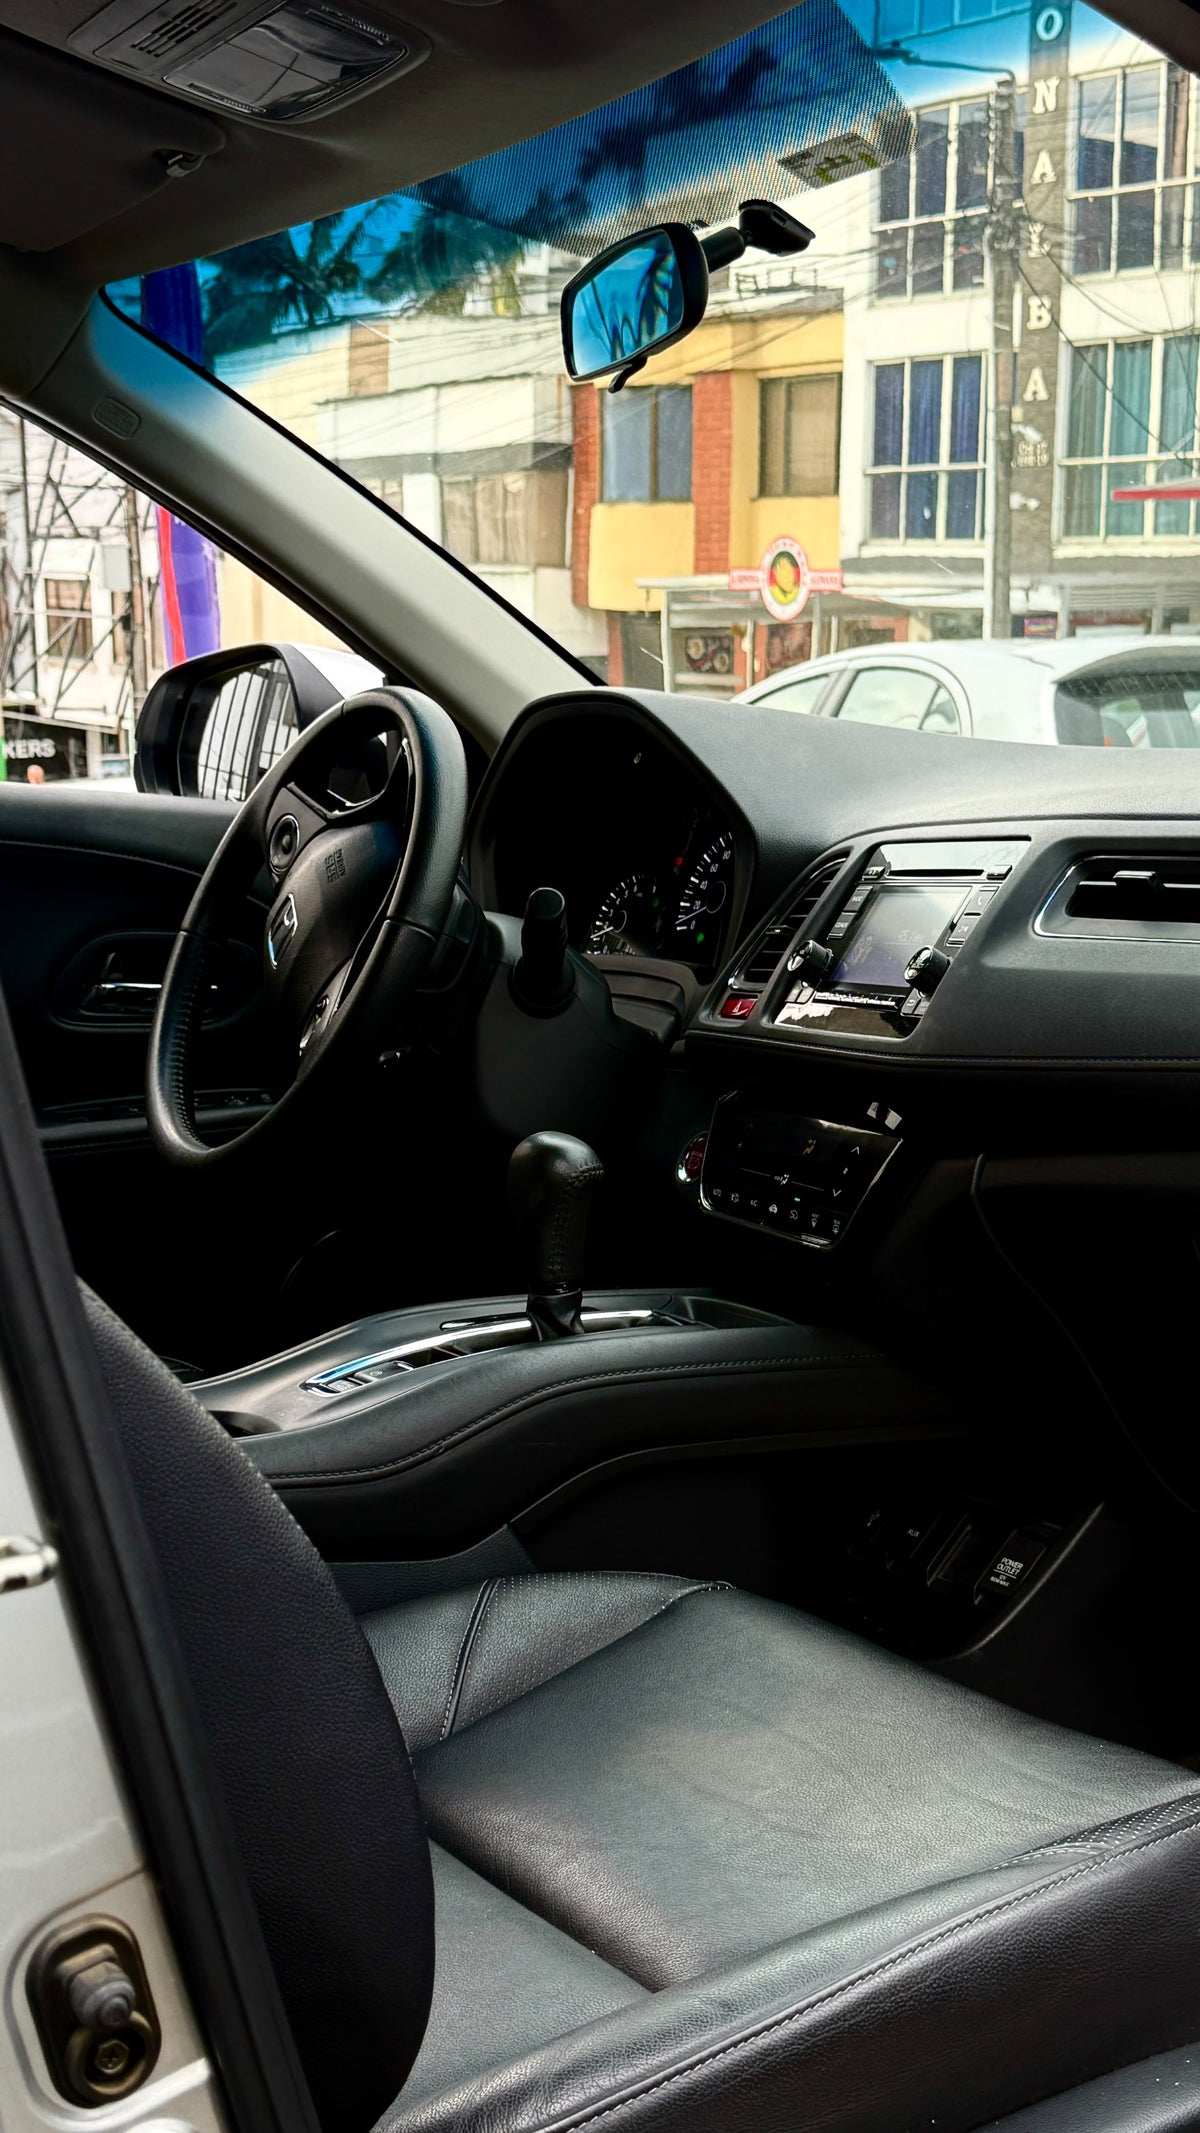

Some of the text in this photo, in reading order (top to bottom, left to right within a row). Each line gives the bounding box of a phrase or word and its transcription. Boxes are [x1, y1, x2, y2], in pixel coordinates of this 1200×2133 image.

[722, 850, 731, 860] 80
[710, 863, 719, 873] 60
[700, 880, 708, 890] 40
[693, 900, 701, 910] 20
[690, 920, 696, 930] 0
[1001, 1557, 1023, 1570] POWER
[996, 1563, 1020, 1576] OUTLET
